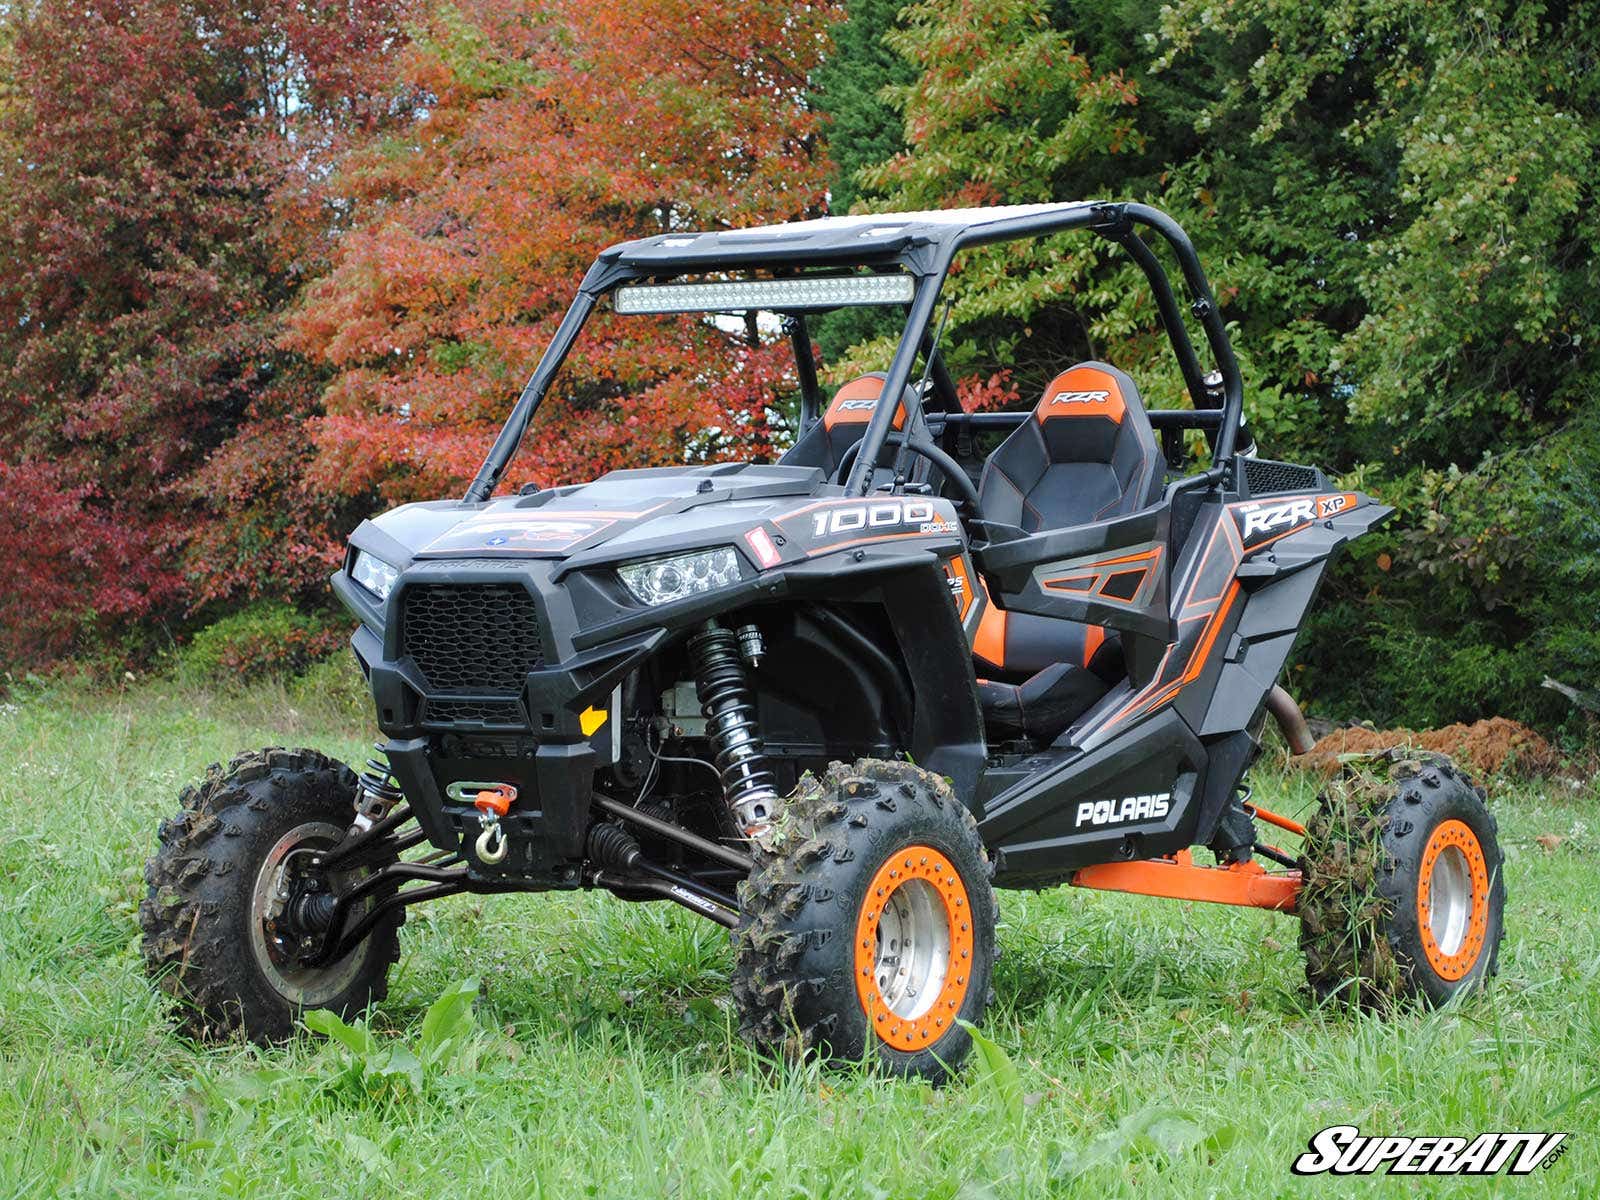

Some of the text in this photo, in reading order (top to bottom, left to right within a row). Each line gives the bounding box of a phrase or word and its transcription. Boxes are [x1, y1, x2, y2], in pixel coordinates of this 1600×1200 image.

[1051, 391, 1110, 405] RZR
[813, 503, 933, 537] 1000
[1243, 497, 1345, 539] RZR XP
[1075, 793, 1170, 827] POLARIS
